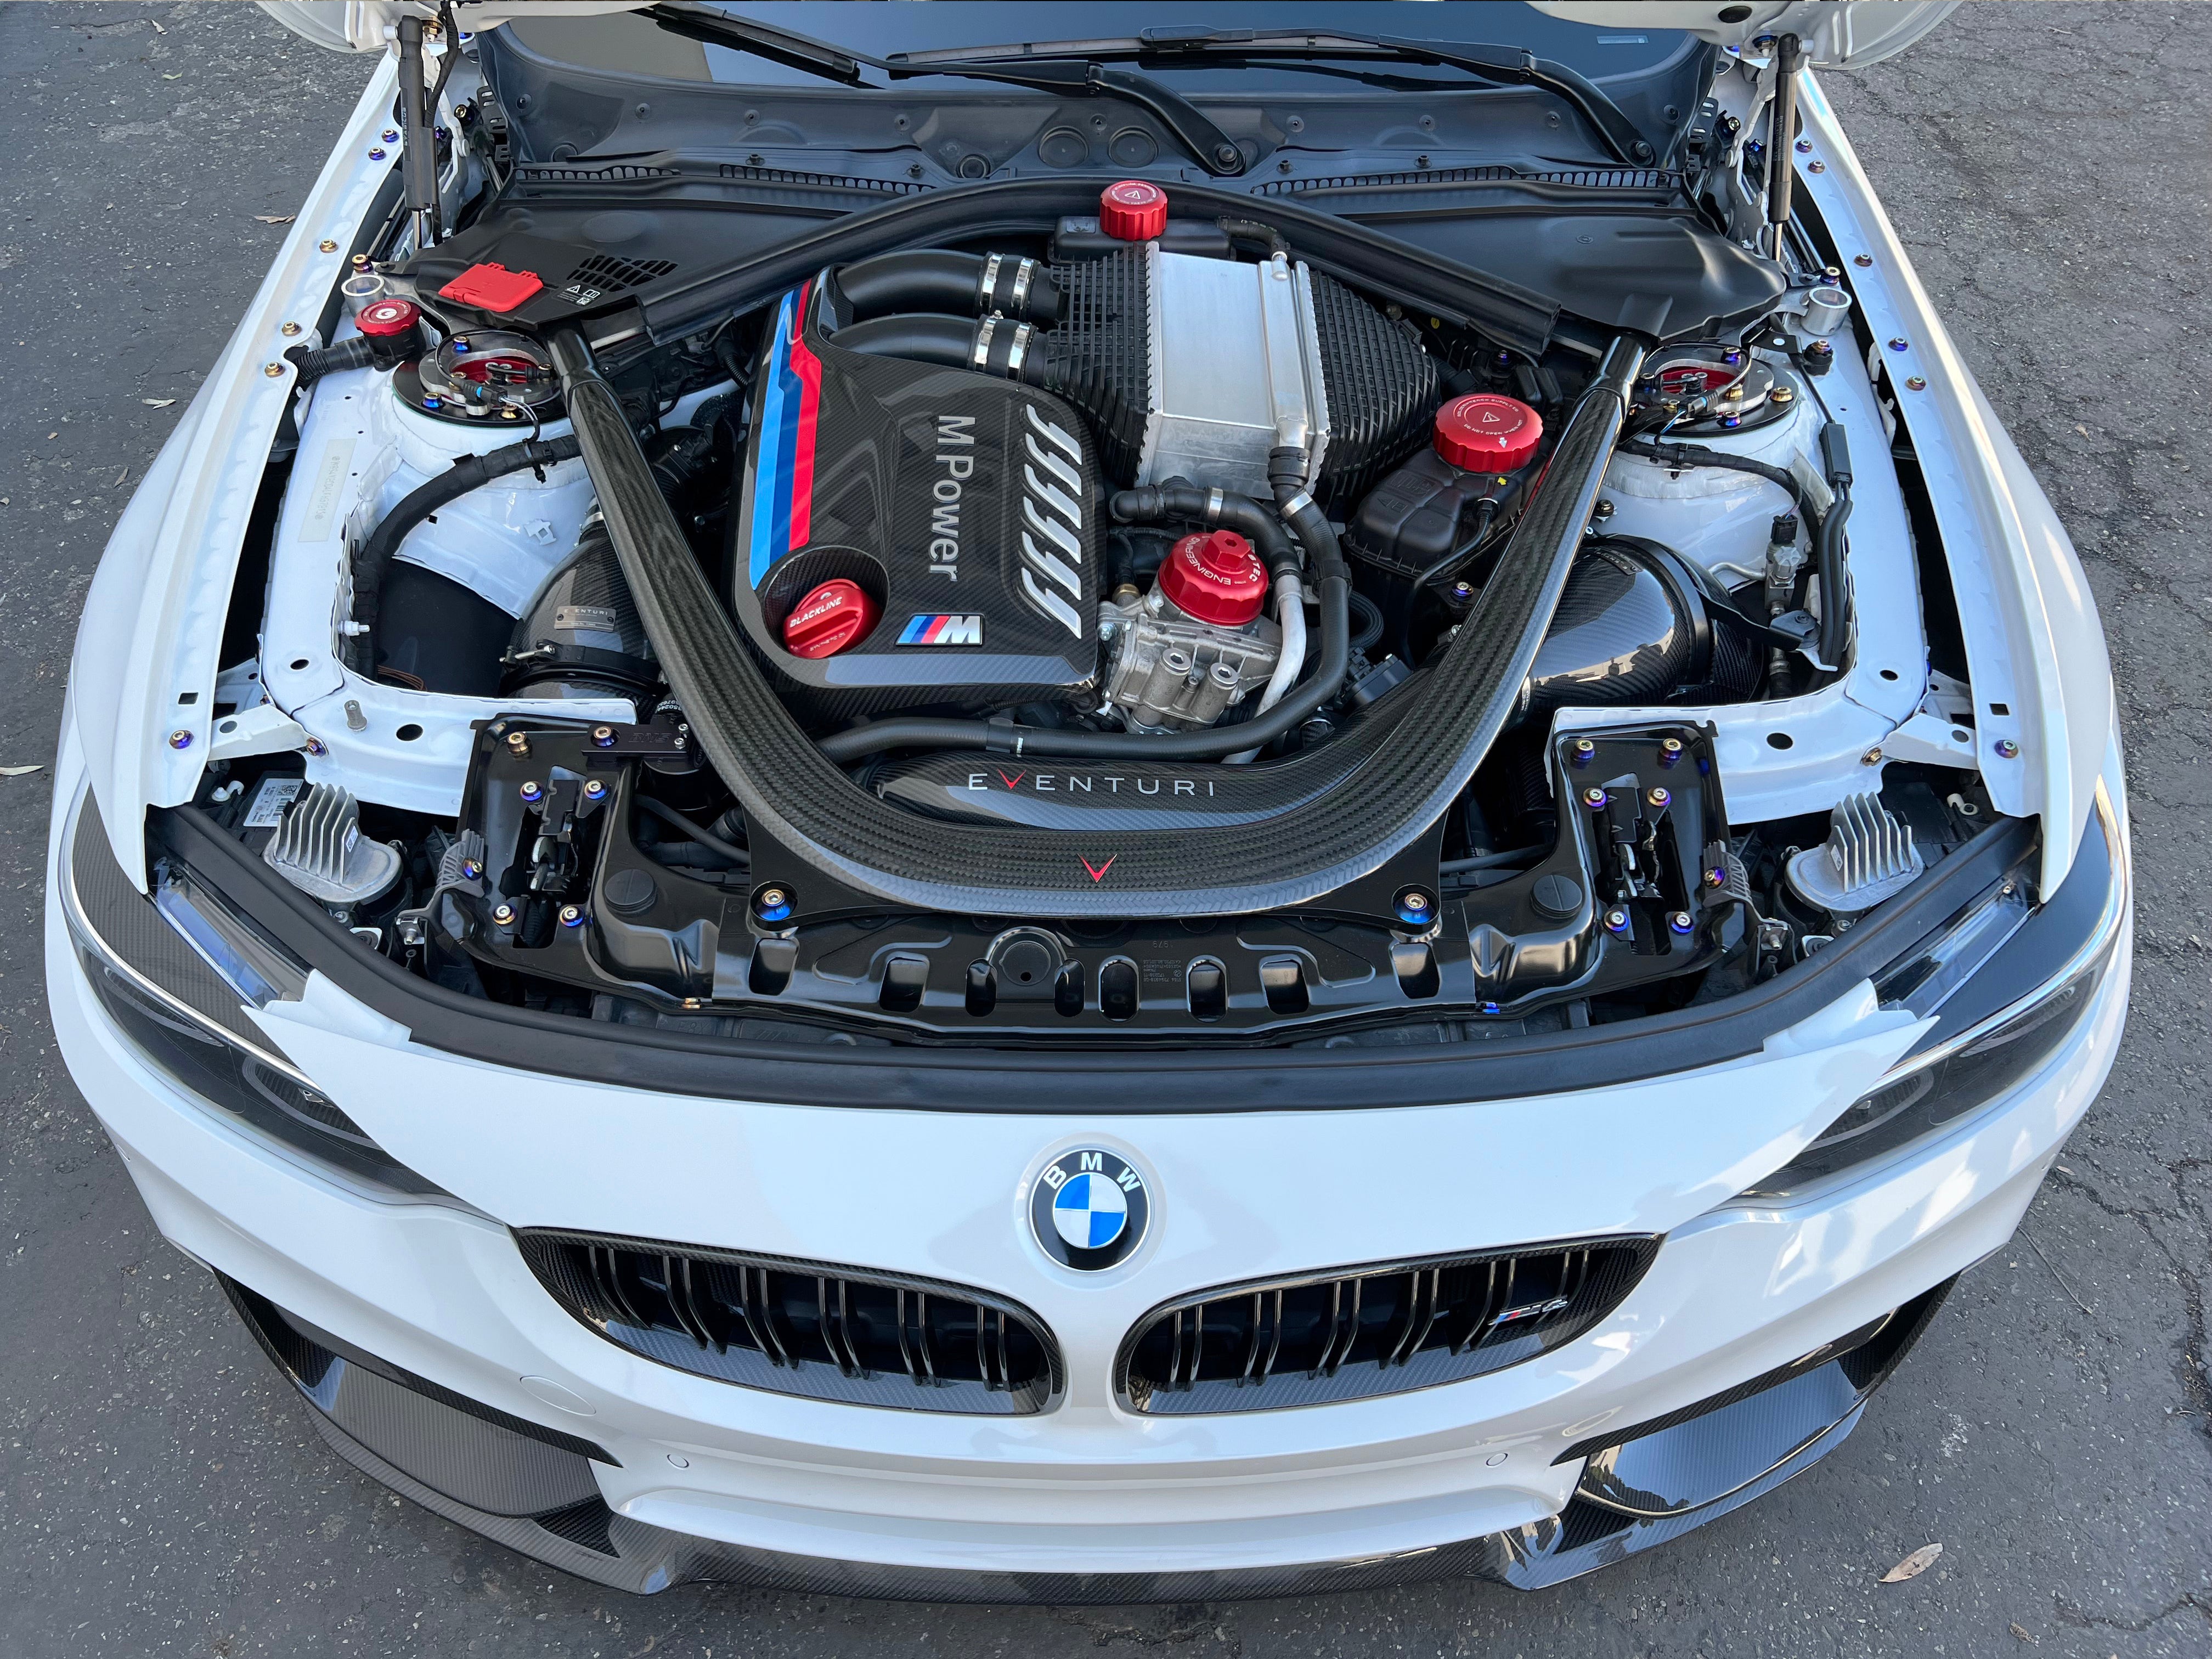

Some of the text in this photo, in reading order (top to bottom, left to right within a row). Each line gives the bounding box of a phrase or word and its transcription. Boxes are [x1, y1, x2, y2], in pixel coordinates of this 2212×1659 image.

[929, 415, 975, 582] M Power
[1185, 537, 1232, 586] ENGINEERING
[789, 596, 843, 628] BLACKLINE
[628, 732, 673, 743] BMS
[968, 769, 1214, 797] EVENTURI
[1042, 1152, 1142, 1193] BMW
